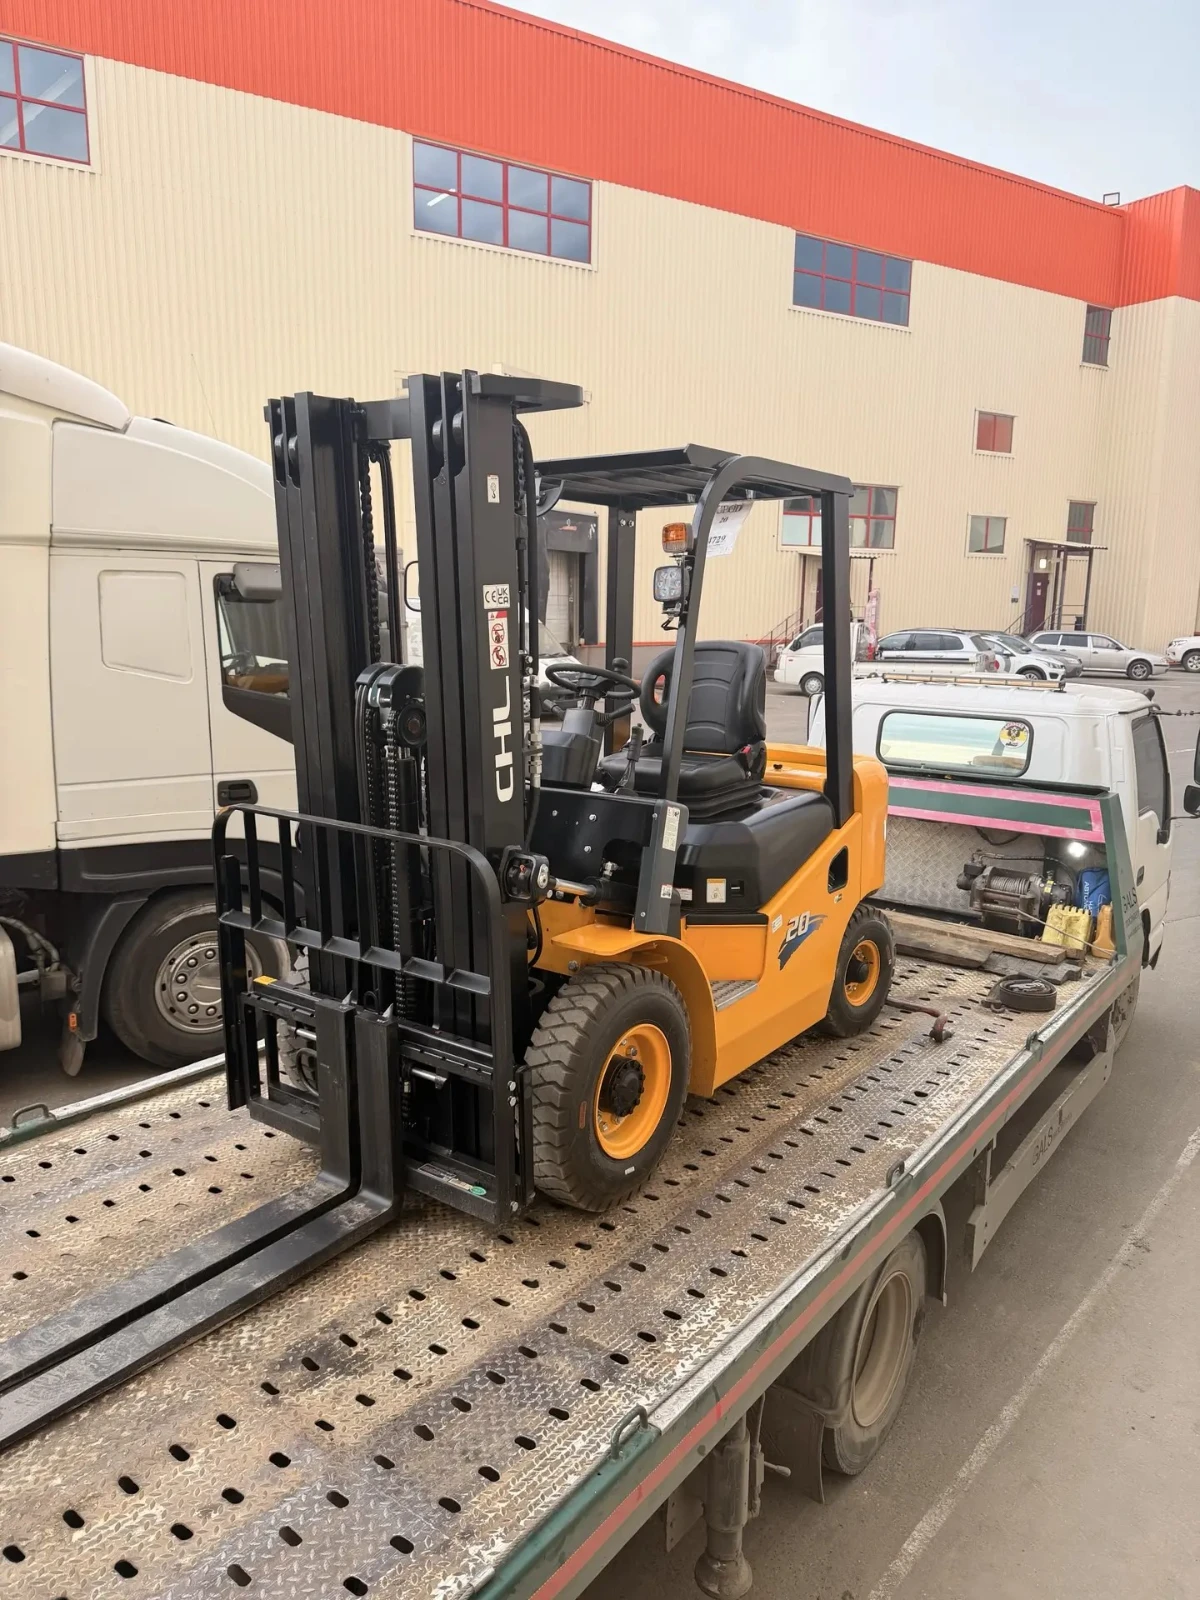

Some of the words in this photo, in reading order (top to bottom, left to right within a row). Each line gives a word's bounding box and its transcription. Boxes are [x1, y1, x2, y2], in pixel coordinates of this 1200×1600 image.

[485, 591, 497, 603] CE
[497, 588, 508, 596] UK
[497, 597, 509, 605] CA
[493, 675, 514, 802] CHL
[786, 910, 810, 942] 20
